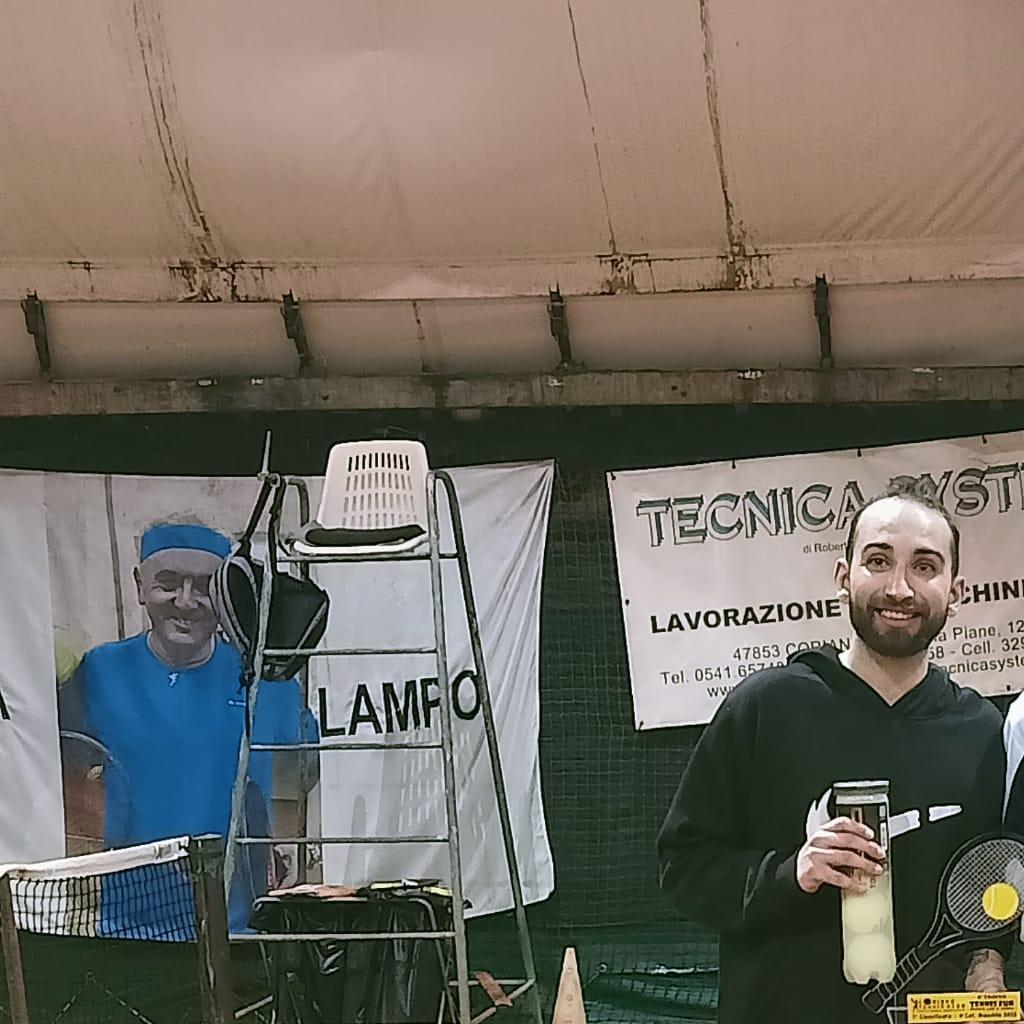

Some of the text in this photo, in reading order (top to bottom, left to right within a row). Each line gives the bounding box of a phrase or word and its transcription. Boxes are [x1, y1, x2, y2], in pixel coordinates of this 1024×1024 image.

[636, 480, 866, 547] TECNICA
[650, 598, 842, 634] LAVORAZIONE
[733, 644, 780, 661] 47853
[1007, 619, 1024, 634] 12
[660, 669, 690, 685] Tel.
[318, 669, 484, 738] LAMPO
